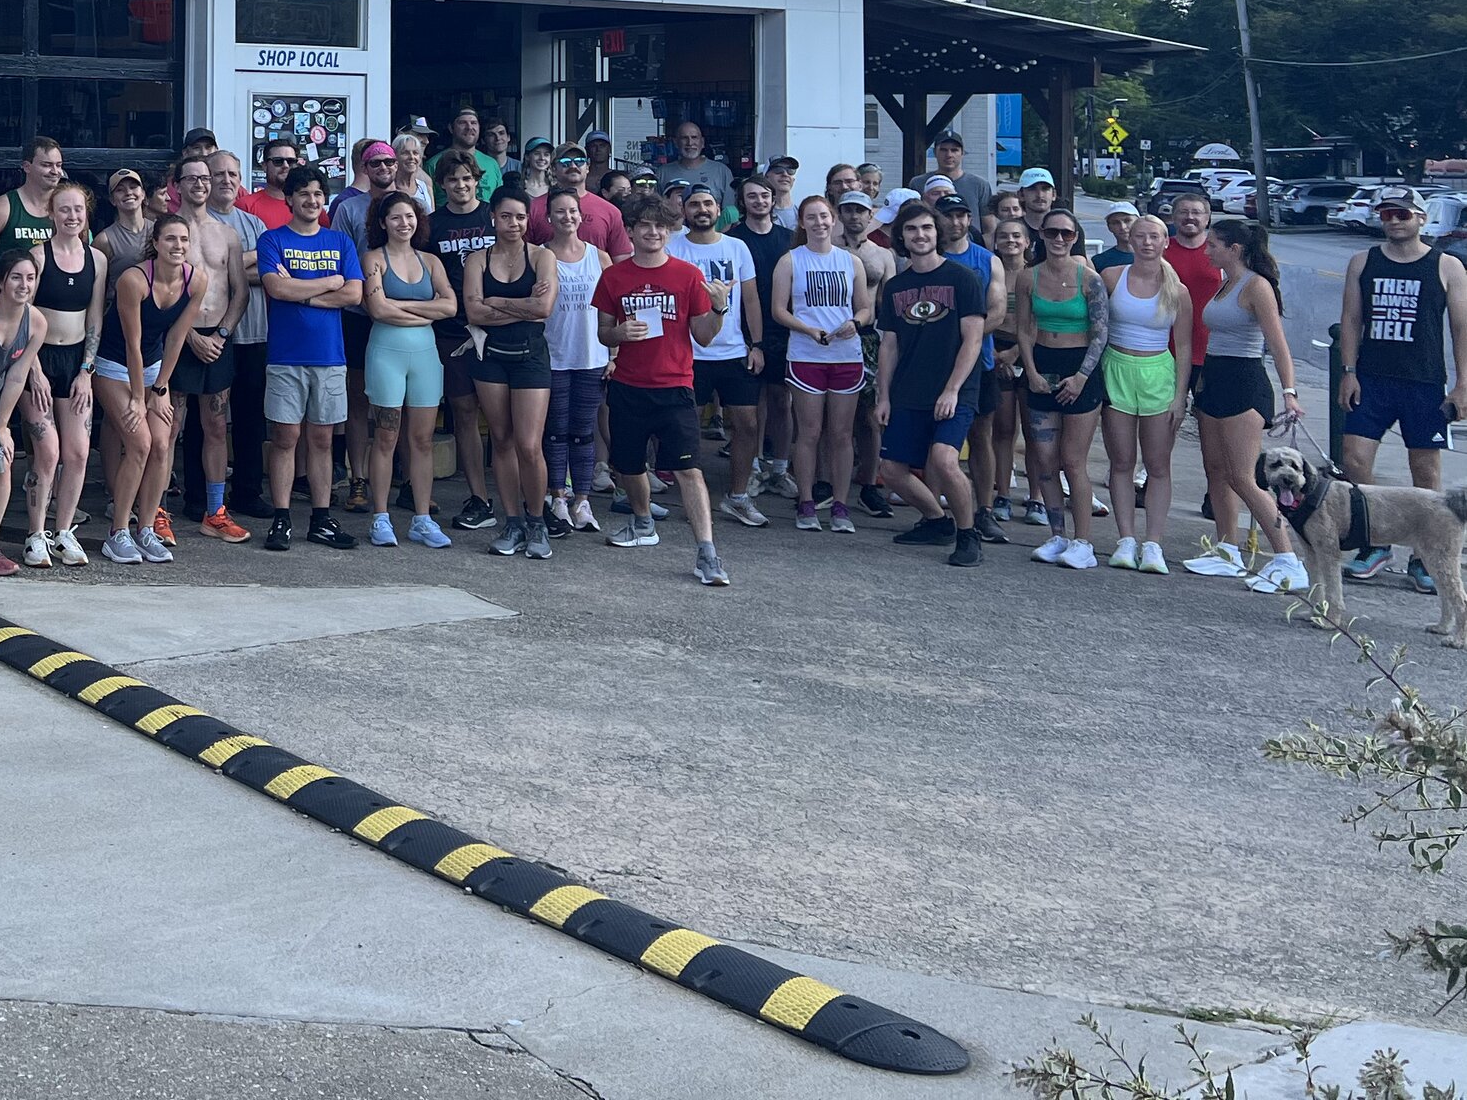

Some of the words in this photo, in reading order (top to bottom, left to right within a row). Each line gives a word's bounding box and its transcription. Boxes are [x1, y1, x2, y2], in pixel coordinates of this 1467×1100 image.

[258, 50, 296, 67] SHOP
[300, 52, 340, 68] LOCAL
[438, 236, 495, 254] BIRDS
[284, 249, 340, 260] WAFFLE
[290, 260, 336, 270] HOUSE
[572, 284, 589, 292] BED
[1373, 278, 1421, 296] THEM
[564, 293, 586, 302] WITH
[1372, 294, 1418, 309] DAWGS
[559, 303, 570, 312] MY
[621, 294, 676, 315] GEORGIA
[1387, 308, 1400, 320] IS
[1370, 320, 1414, 342] HELL
